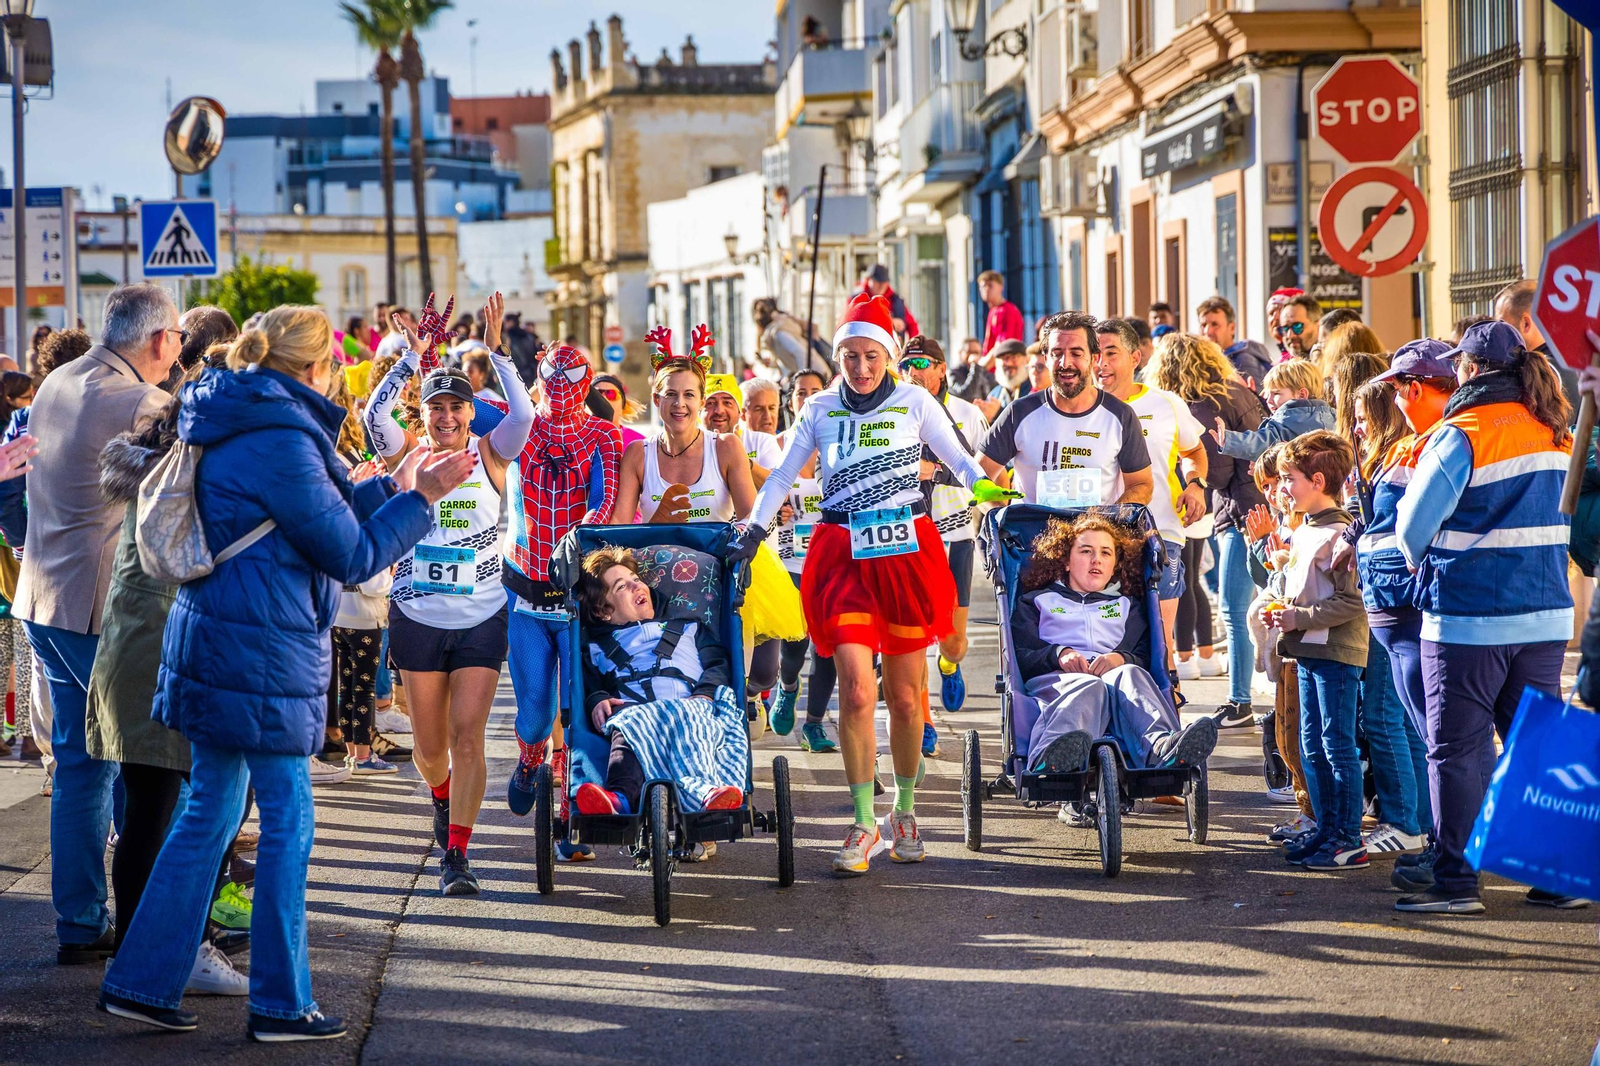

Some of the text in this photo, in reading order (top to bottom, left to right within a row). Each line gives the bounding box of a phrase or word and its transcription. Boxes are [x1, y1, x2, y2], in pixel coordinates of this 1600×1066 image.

[1319, 96, 1417, 126] STOP
[1313, 284, 1358, 296] ANEL
[1493, 412, 1534, 428] PROTE
[860, 421, 895, 431] CARROS
[859, 438, 890, 447] FUEGO
[1061, 446, 1092, 456] CARROS
[1061, 455, 1071, 463] DE
[440, 500, 477, 509] CARROS
[440, 510, 452, 518] DE
[440, 519, 469, 528] FUEGO
[860, 523, 909, 545] 103
[428, 562, 459, 582] 61
